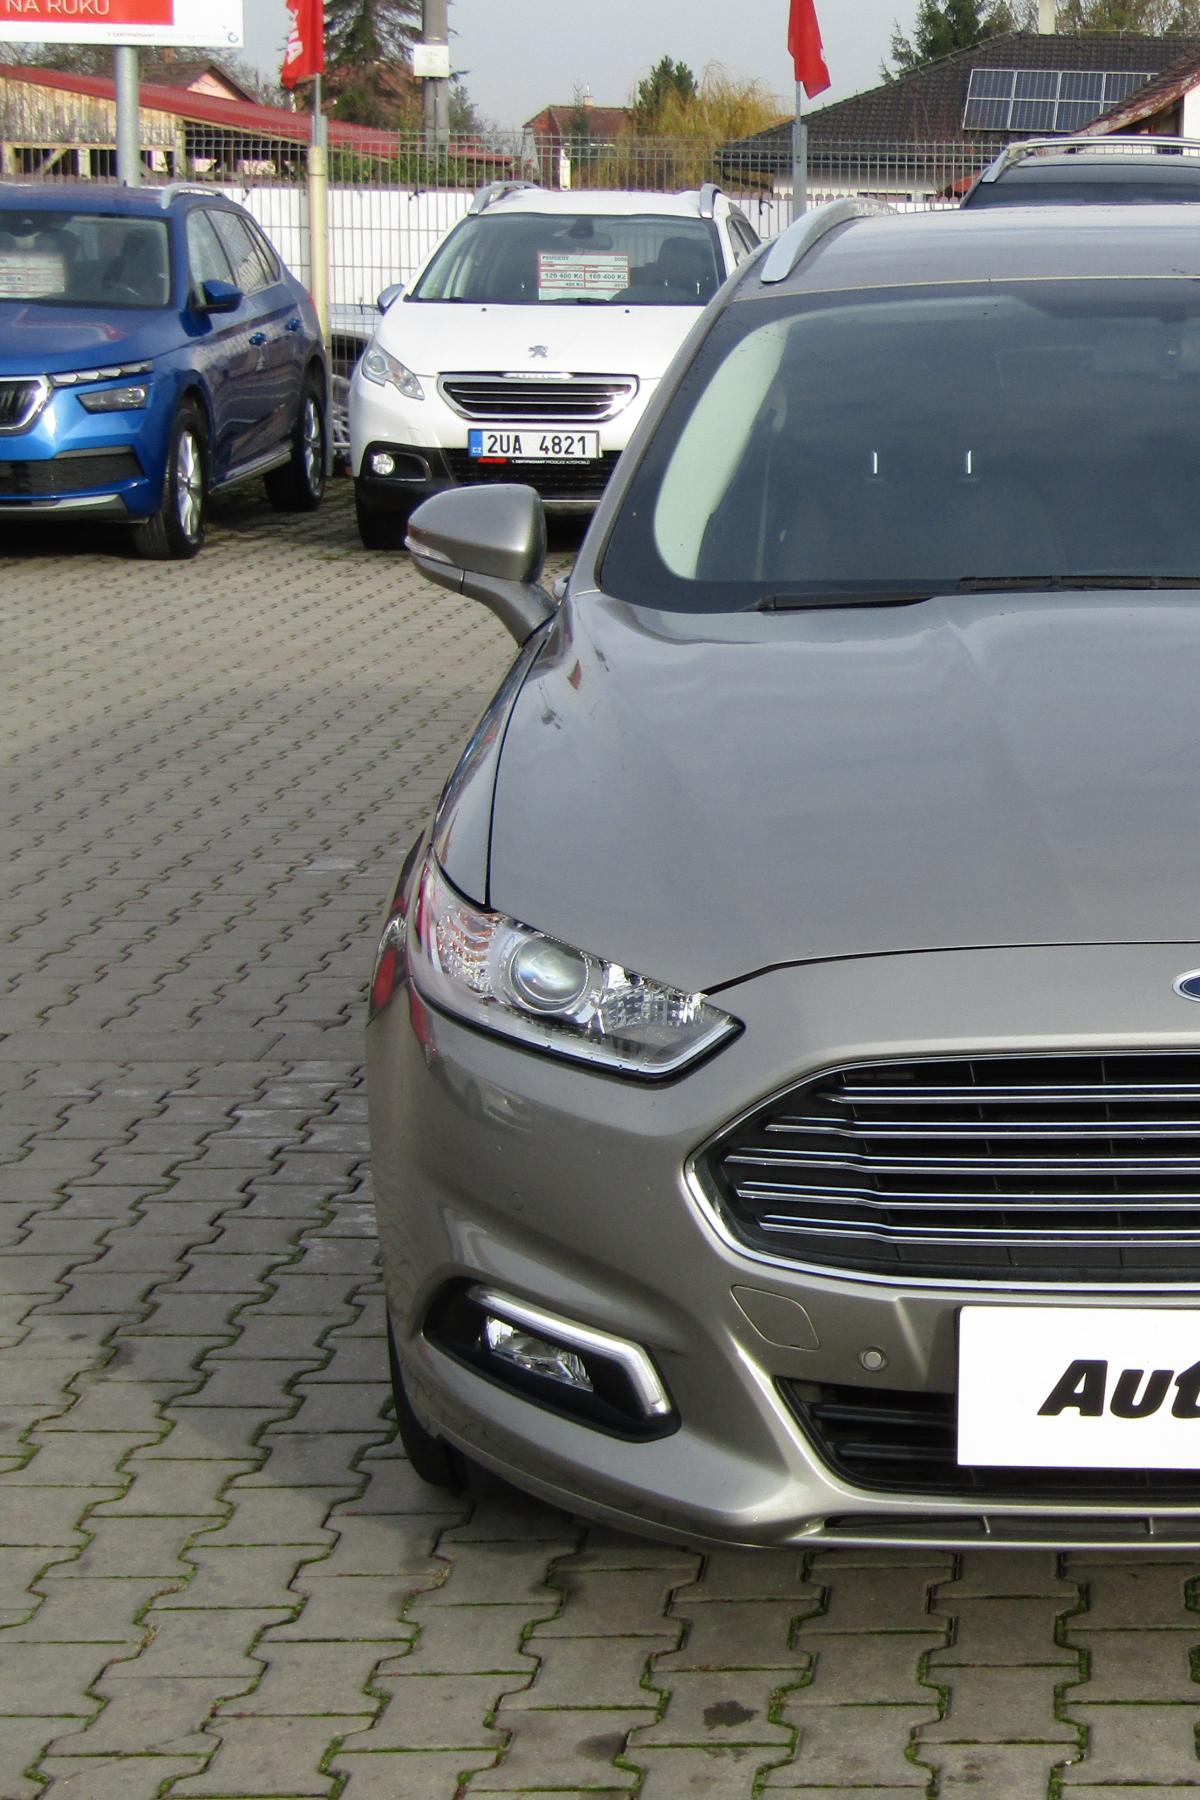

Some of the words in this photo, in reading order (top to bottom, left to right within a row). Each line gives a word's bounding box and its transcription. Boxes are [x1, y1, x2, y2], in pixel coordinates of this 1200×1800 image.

[6, 0, 40, 13] NA
[47, 0, 110, 15] RUKU
[487, 434, 522, 454] 2UA
[539, 435, 586, 455] 4821
